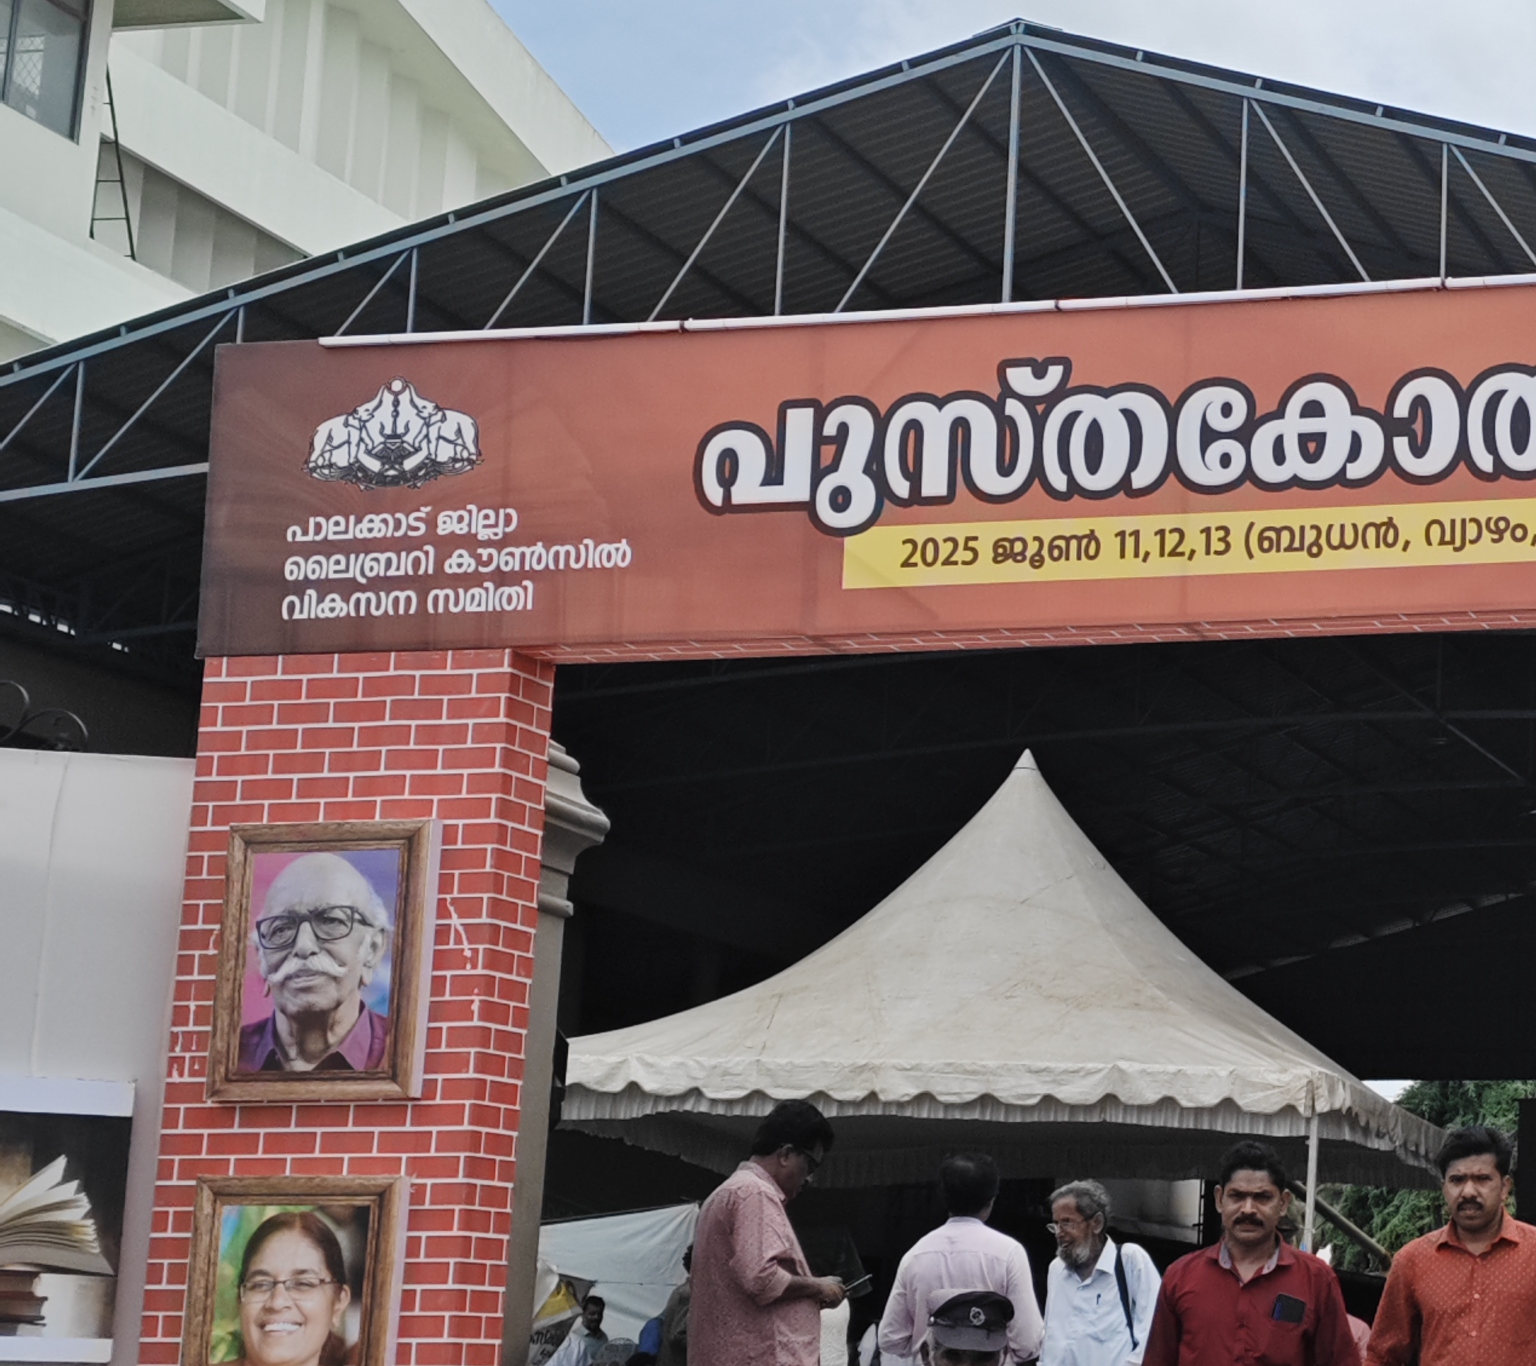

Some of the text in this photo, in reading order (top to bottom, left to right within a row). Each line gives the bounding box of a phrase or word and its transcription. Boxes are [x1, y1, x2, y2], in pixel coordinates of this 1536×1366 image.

[286, 504, 518, 542] പാലക്കാട് ജില്ലാ
[284, 539, 632, 584] ലൈബ്രറി കൗൺസിൽ
[900, 535, 980, 569] 2025
[991, 529, 1101, 570] ജൂൺ
[1113, 524, 1232, 564] 11,12,13
[281, 580, 534, 620] വികസന സമിതി
